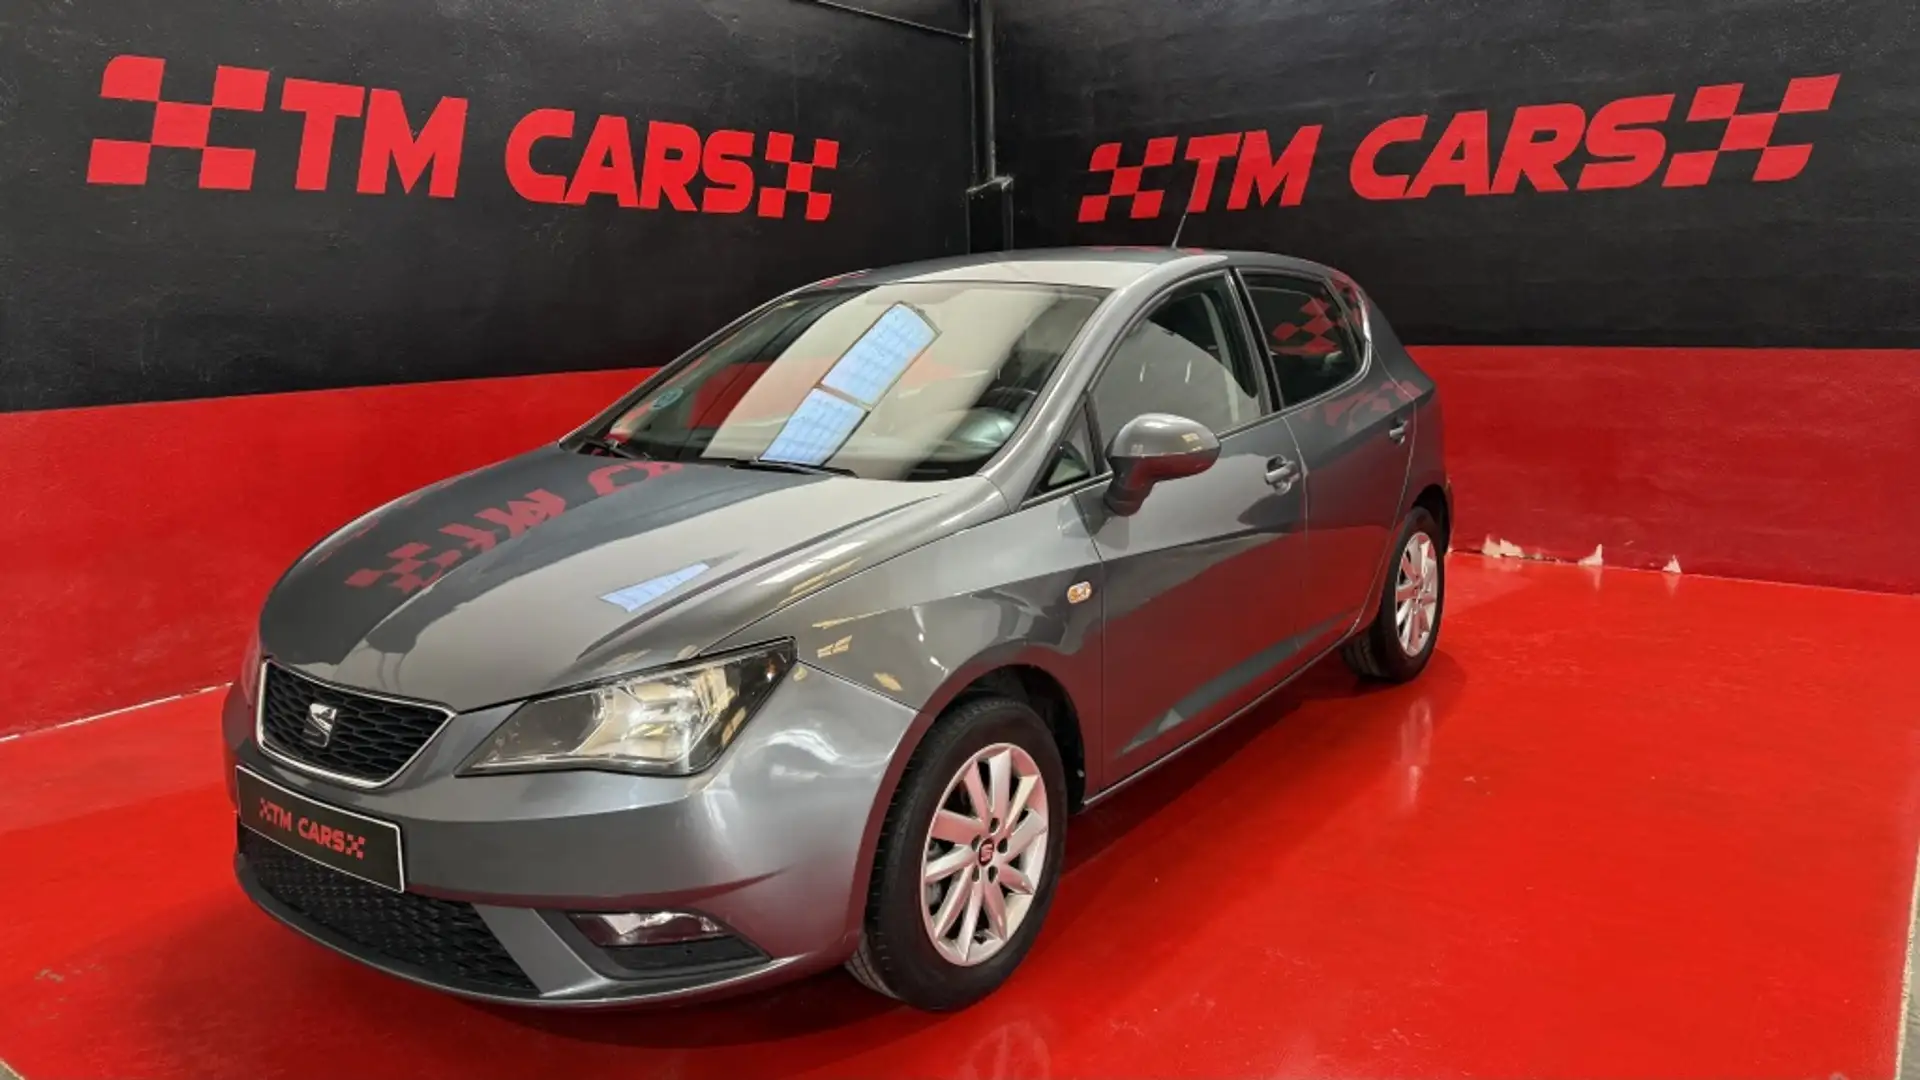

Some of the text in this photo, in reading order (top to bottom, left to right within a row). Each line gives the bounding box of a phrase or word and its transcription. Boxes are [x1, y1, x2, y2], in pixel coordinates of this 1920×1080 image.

[280, 77, 754, 213] TM CARS
[1185, 94, 1676, 212] TM CARS
[270, 802, 345, 852] TM CARS
